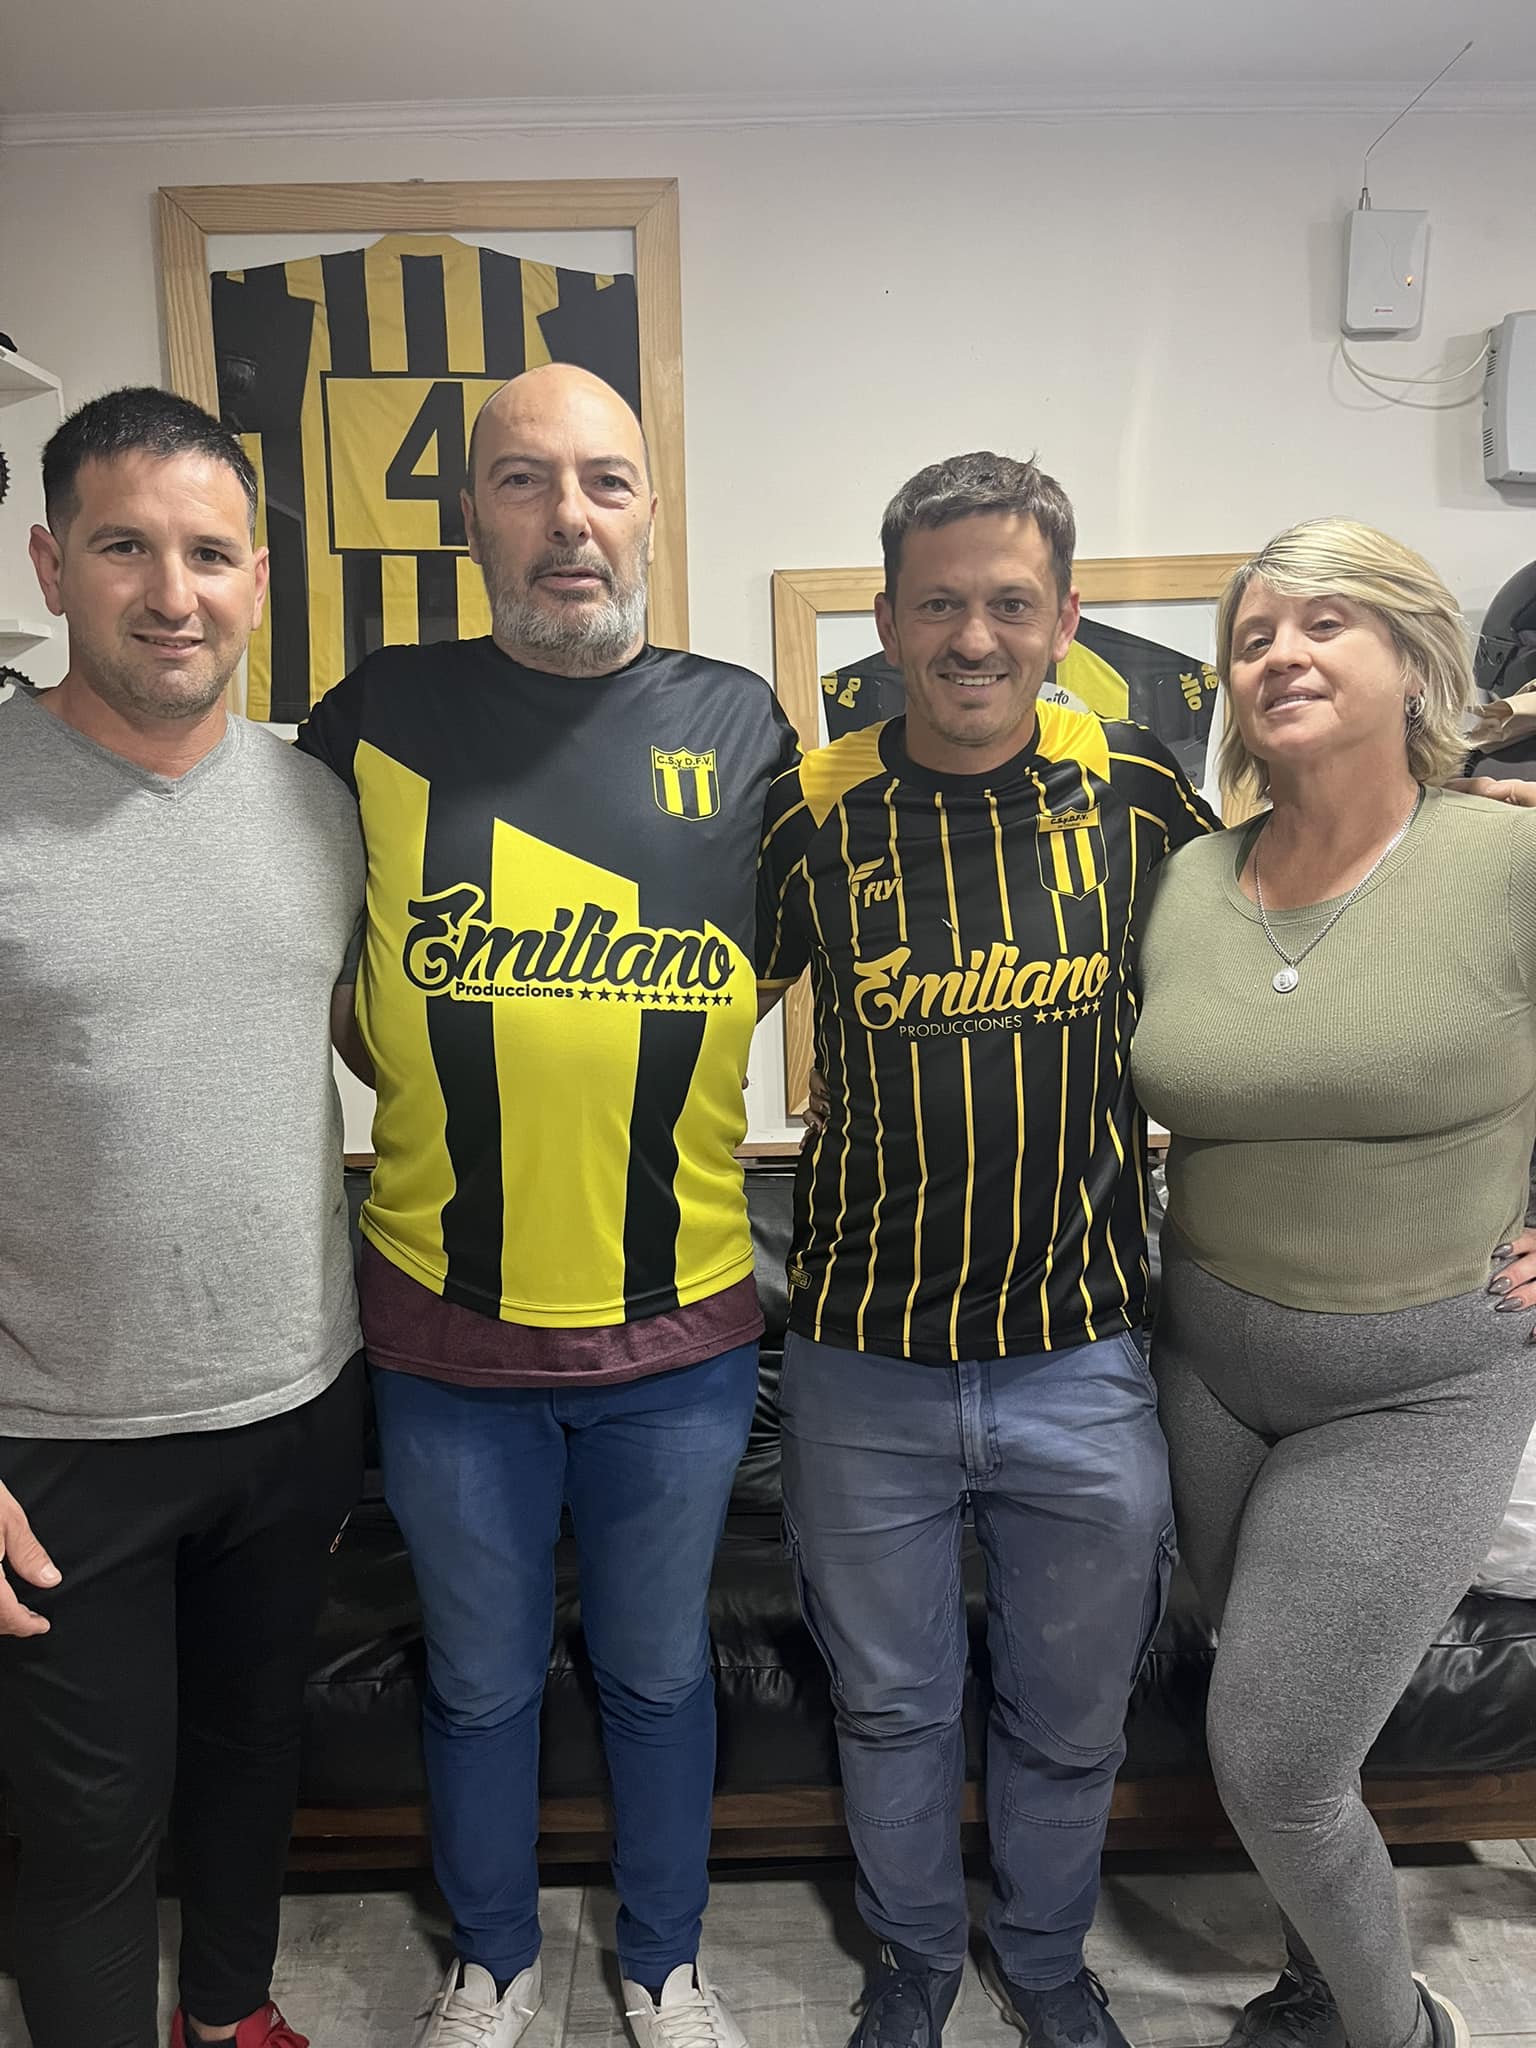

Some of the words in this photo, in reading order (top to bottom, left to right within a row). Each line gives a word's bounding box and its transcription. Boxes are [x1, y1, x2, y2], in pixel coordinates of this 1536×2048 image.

[385, 381, 469, 547] 4
[403, 886, 736, 991] Emiliano
[455, 981, 574, 999] Producciones
[853, 942, 1112, 1030] Emiliano
[899, 1014, 1023, 1038] PRODUCCIONES
